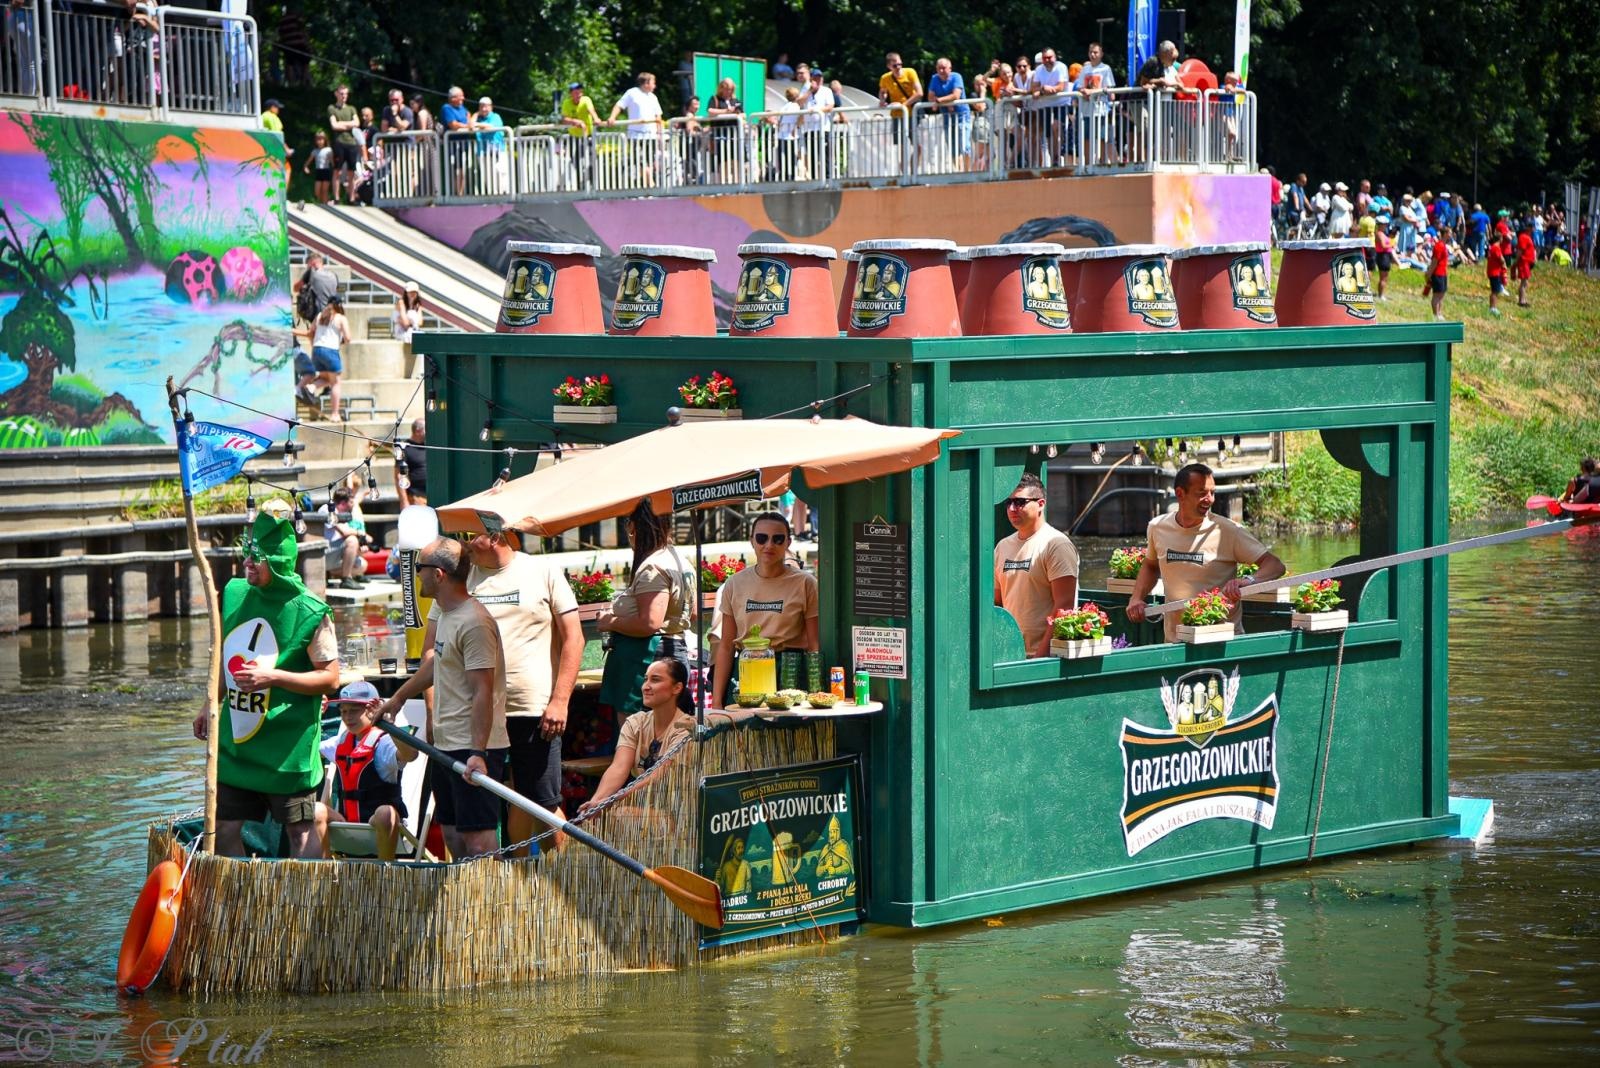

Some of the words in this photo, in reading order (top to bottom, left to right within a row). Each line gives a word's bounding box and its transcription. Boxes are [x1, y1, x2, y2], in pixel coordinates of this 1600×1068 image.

[675, 478, 759, 505] GRZEGORZOWICKIE
[869, 526, 891, 535] Cennik
[401, 553, 414, 627] GRZEGORZOWICKIE
[228, 688, 266, 714] EER
[1131, 736, 1272, 796] GRZEGORZOWICKIE
[710, 792, 848, 835] GRZEGORZOWICKIE
[817, 877, 848, 891] CHROBRY
